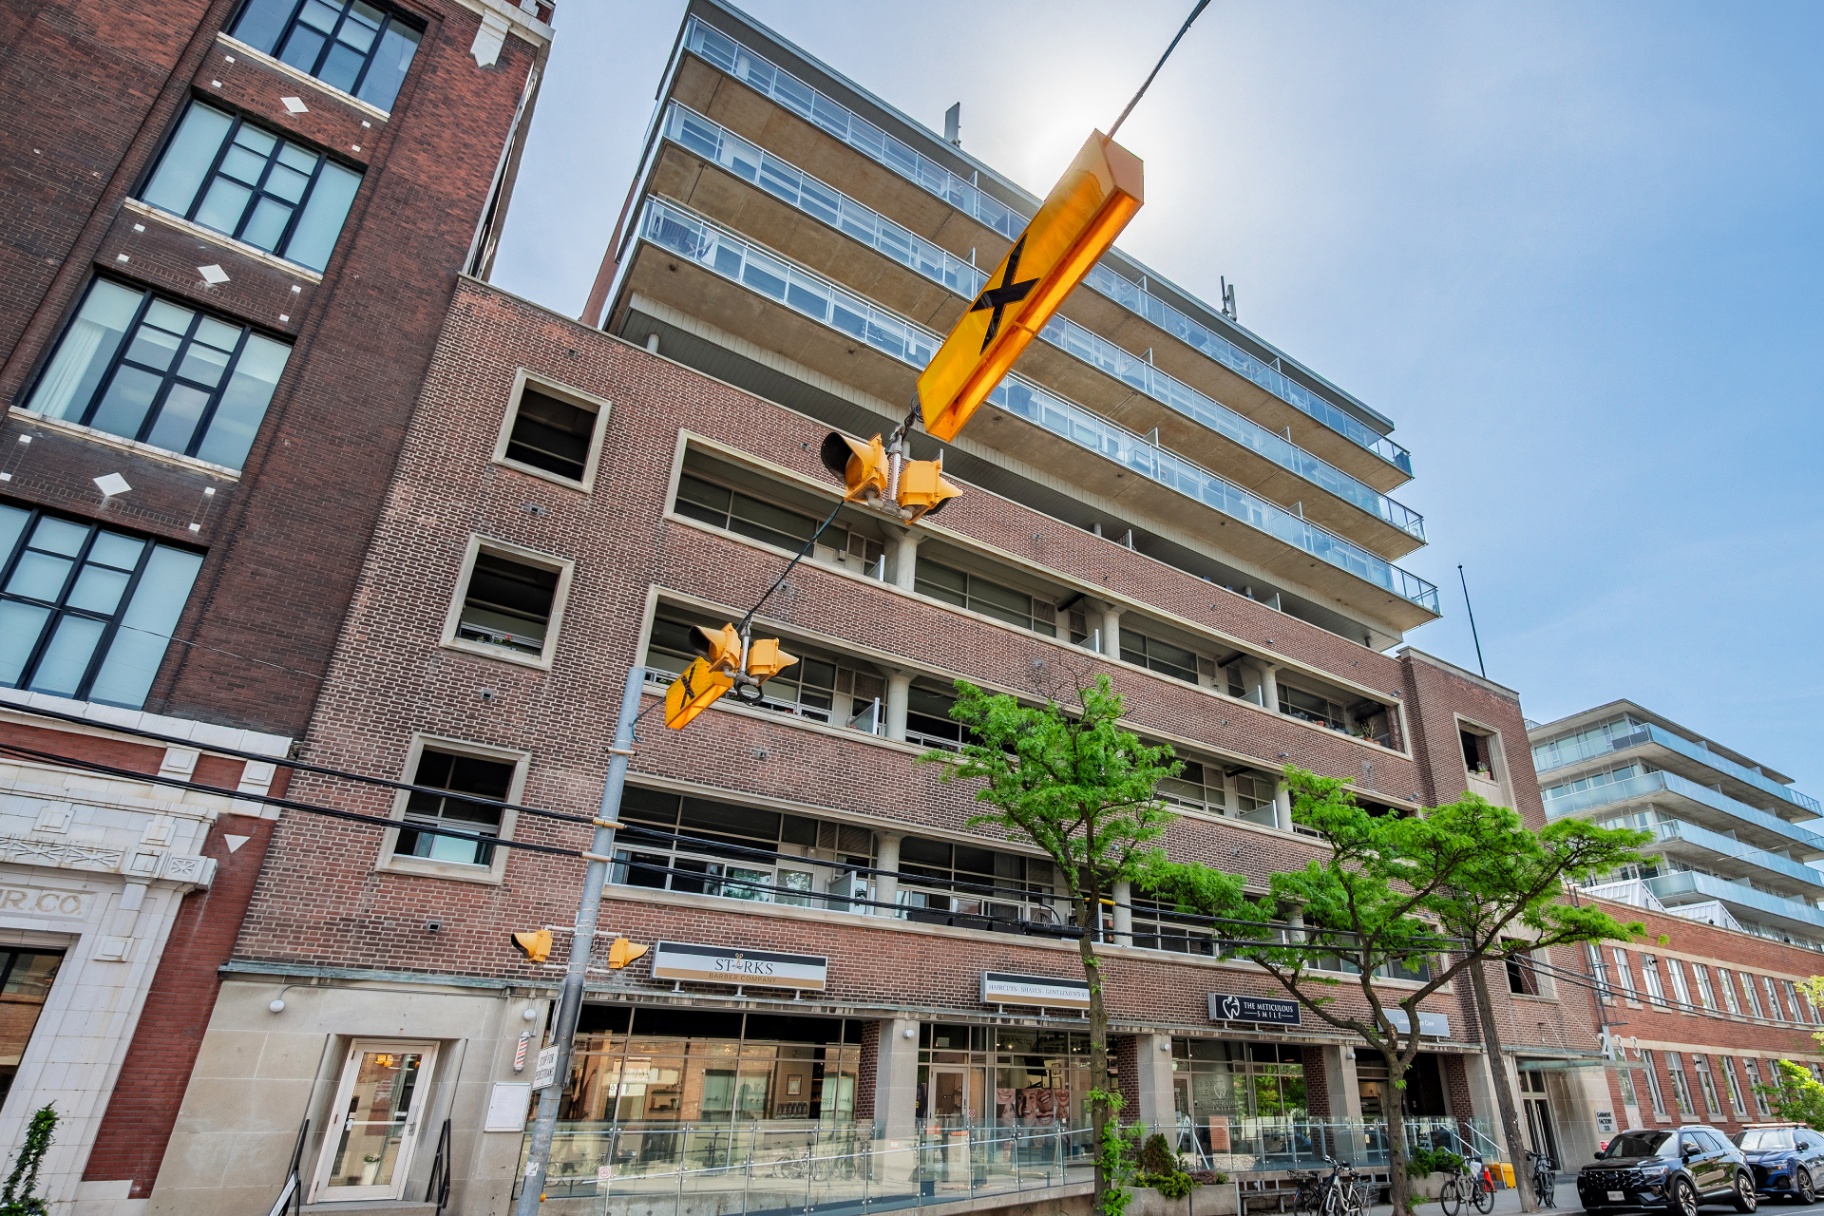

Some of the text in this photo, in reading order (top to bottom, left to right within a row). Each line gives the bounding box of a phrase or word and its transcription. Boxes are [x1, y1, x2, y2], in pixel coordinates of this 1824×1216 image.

[708, 972, 777, 984] BARBER COMPANY
[988, 983, 1018, 993] HAIRCUTS
[1020, 986, 1042, 994] SHAVES
[1243, 1001, 1294, 1013] THE METICULOUS
[1256, 1011, 1282, 1019] SMILE
[1597, 1032, 1642, 1058] 233
